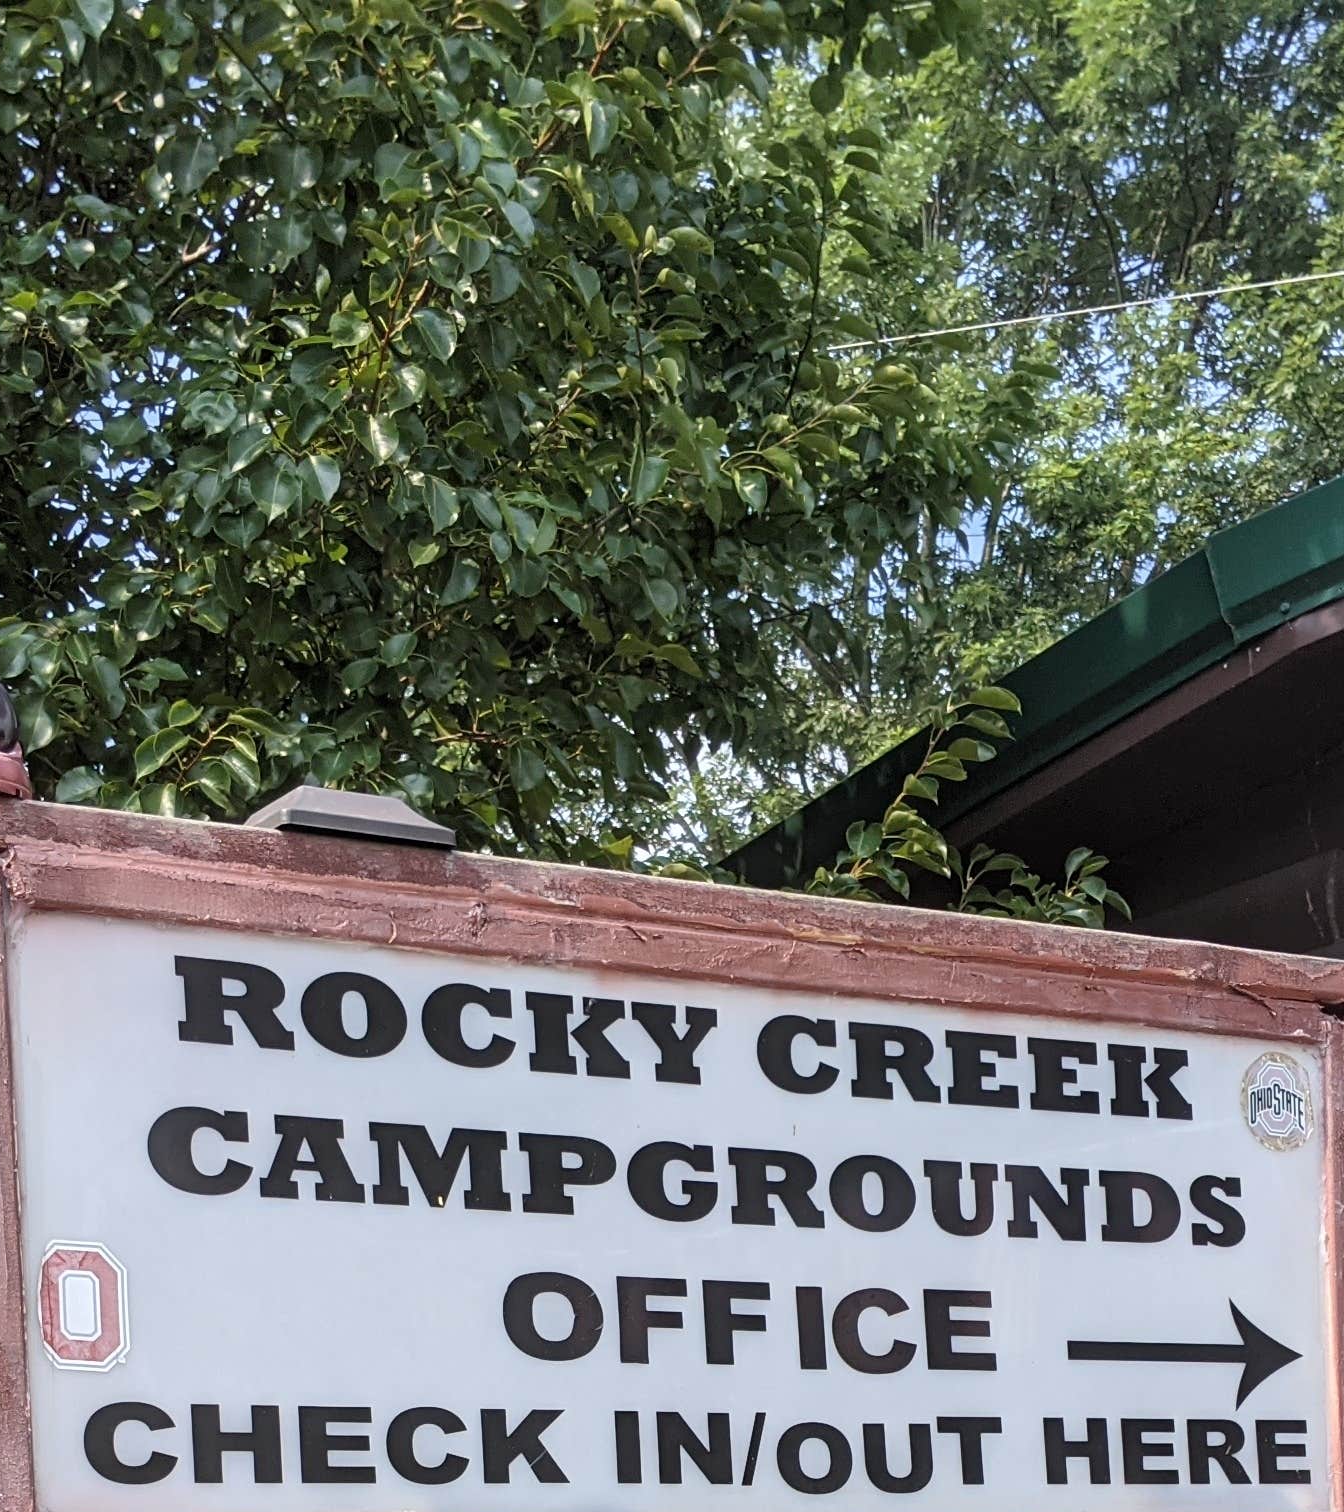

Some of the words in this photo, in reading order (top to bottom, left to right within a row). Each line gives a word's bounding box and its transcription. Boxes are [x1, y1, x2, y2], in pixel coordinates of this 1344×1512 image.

[175, 956, 717, 1085] ROCKY
[757, 1015, 1192, 1120] CREEK
[148, 1107, 1245, 1247] CAMPGROUNDS
[503, 1272, 997, 1374] OFFICE
[84, 1402, 569, 1489] CHECK
[615, 1411, 1002, 1494] IN/OUT
[1043, 1418, 1311, 1485] HERE
